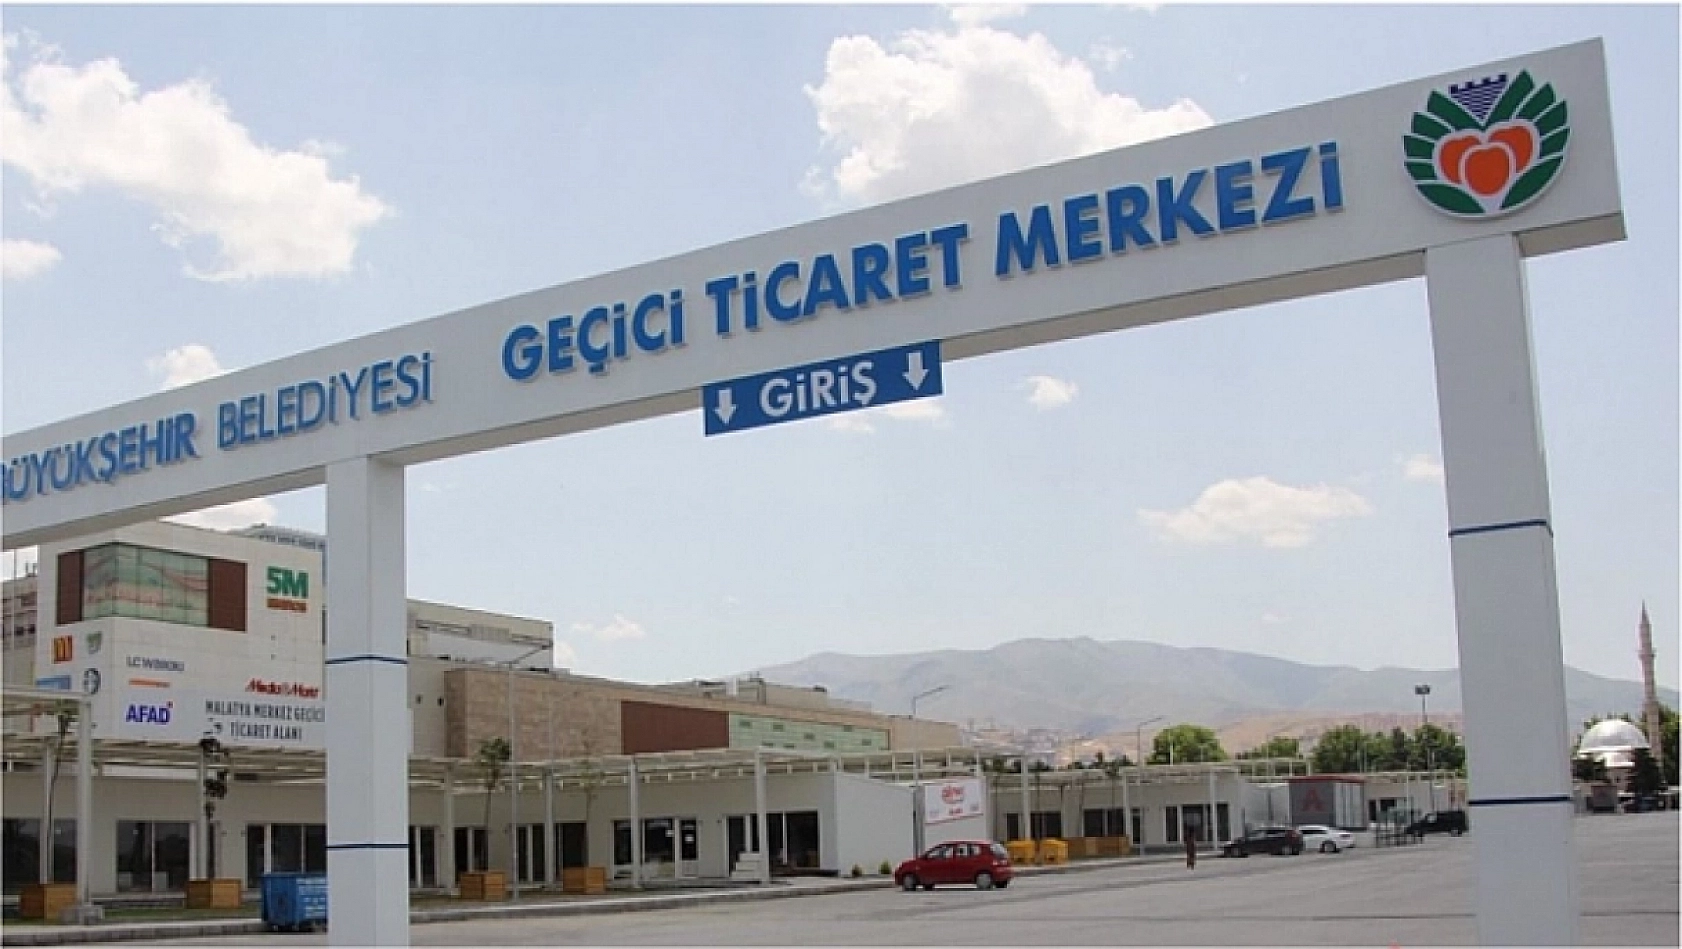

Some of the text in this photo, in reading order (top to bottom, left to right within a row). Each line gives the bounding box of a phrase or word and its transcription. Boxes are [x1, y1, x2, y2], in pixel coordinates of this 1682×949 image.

[503, 141, 1343, 381] GEÇİCİ TİCARET MERKEZİ
[217, 352, 432, 449] BELEDİYESİ
[760, 361, 877, 418] GİRİŞ
[266, 566, 309, 599] 5M
[126, 703, 170, 724] AFAD
[205, 699, 250, 717] MALATYA
